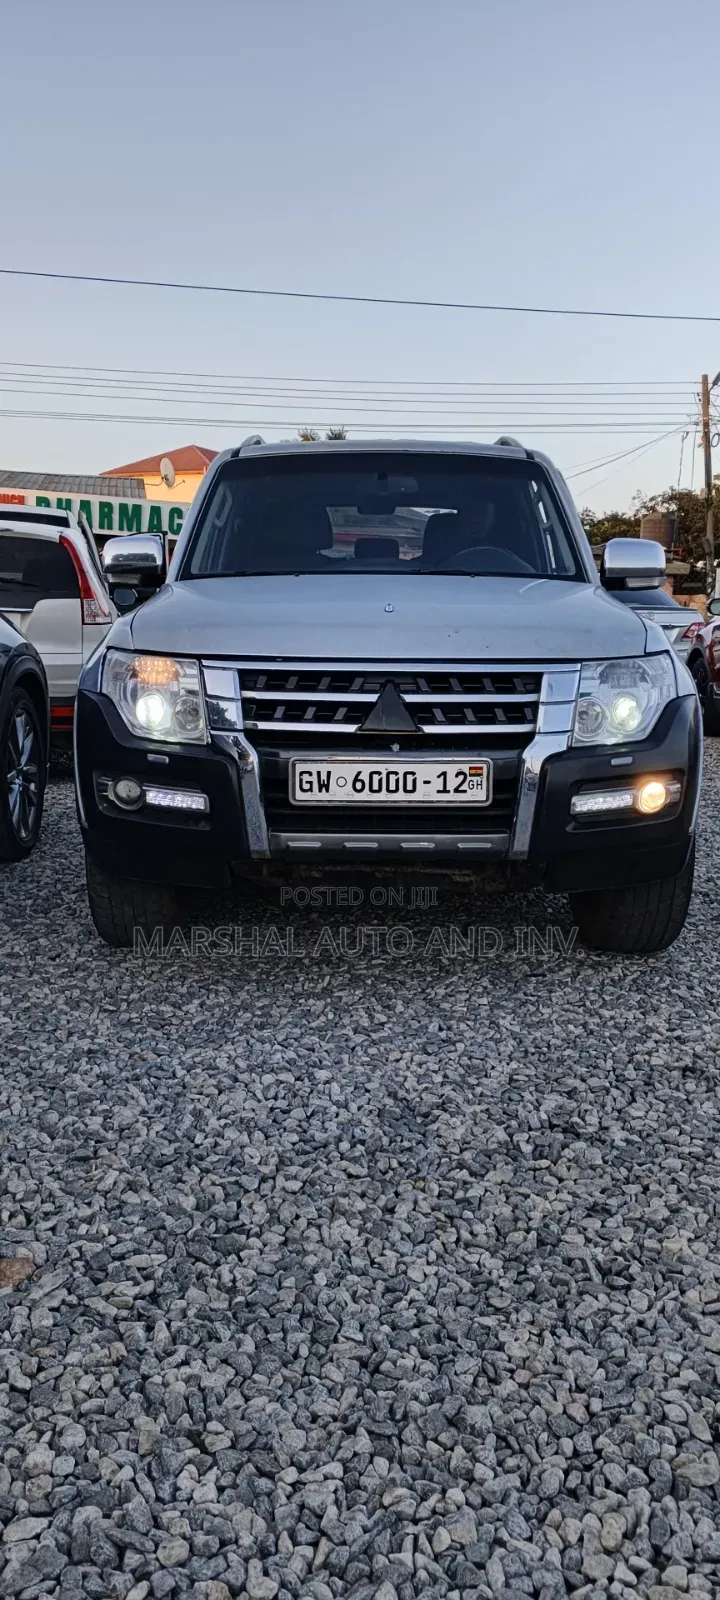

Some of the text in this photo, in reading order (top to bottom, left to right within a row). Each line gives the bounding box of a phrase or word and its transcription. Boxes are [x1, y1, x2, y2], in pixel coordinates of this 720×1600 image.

[36, 496, 189, 535] ARMAC
[299, 771, 332, 793] GW
[468, 780, 483, 790] GH
